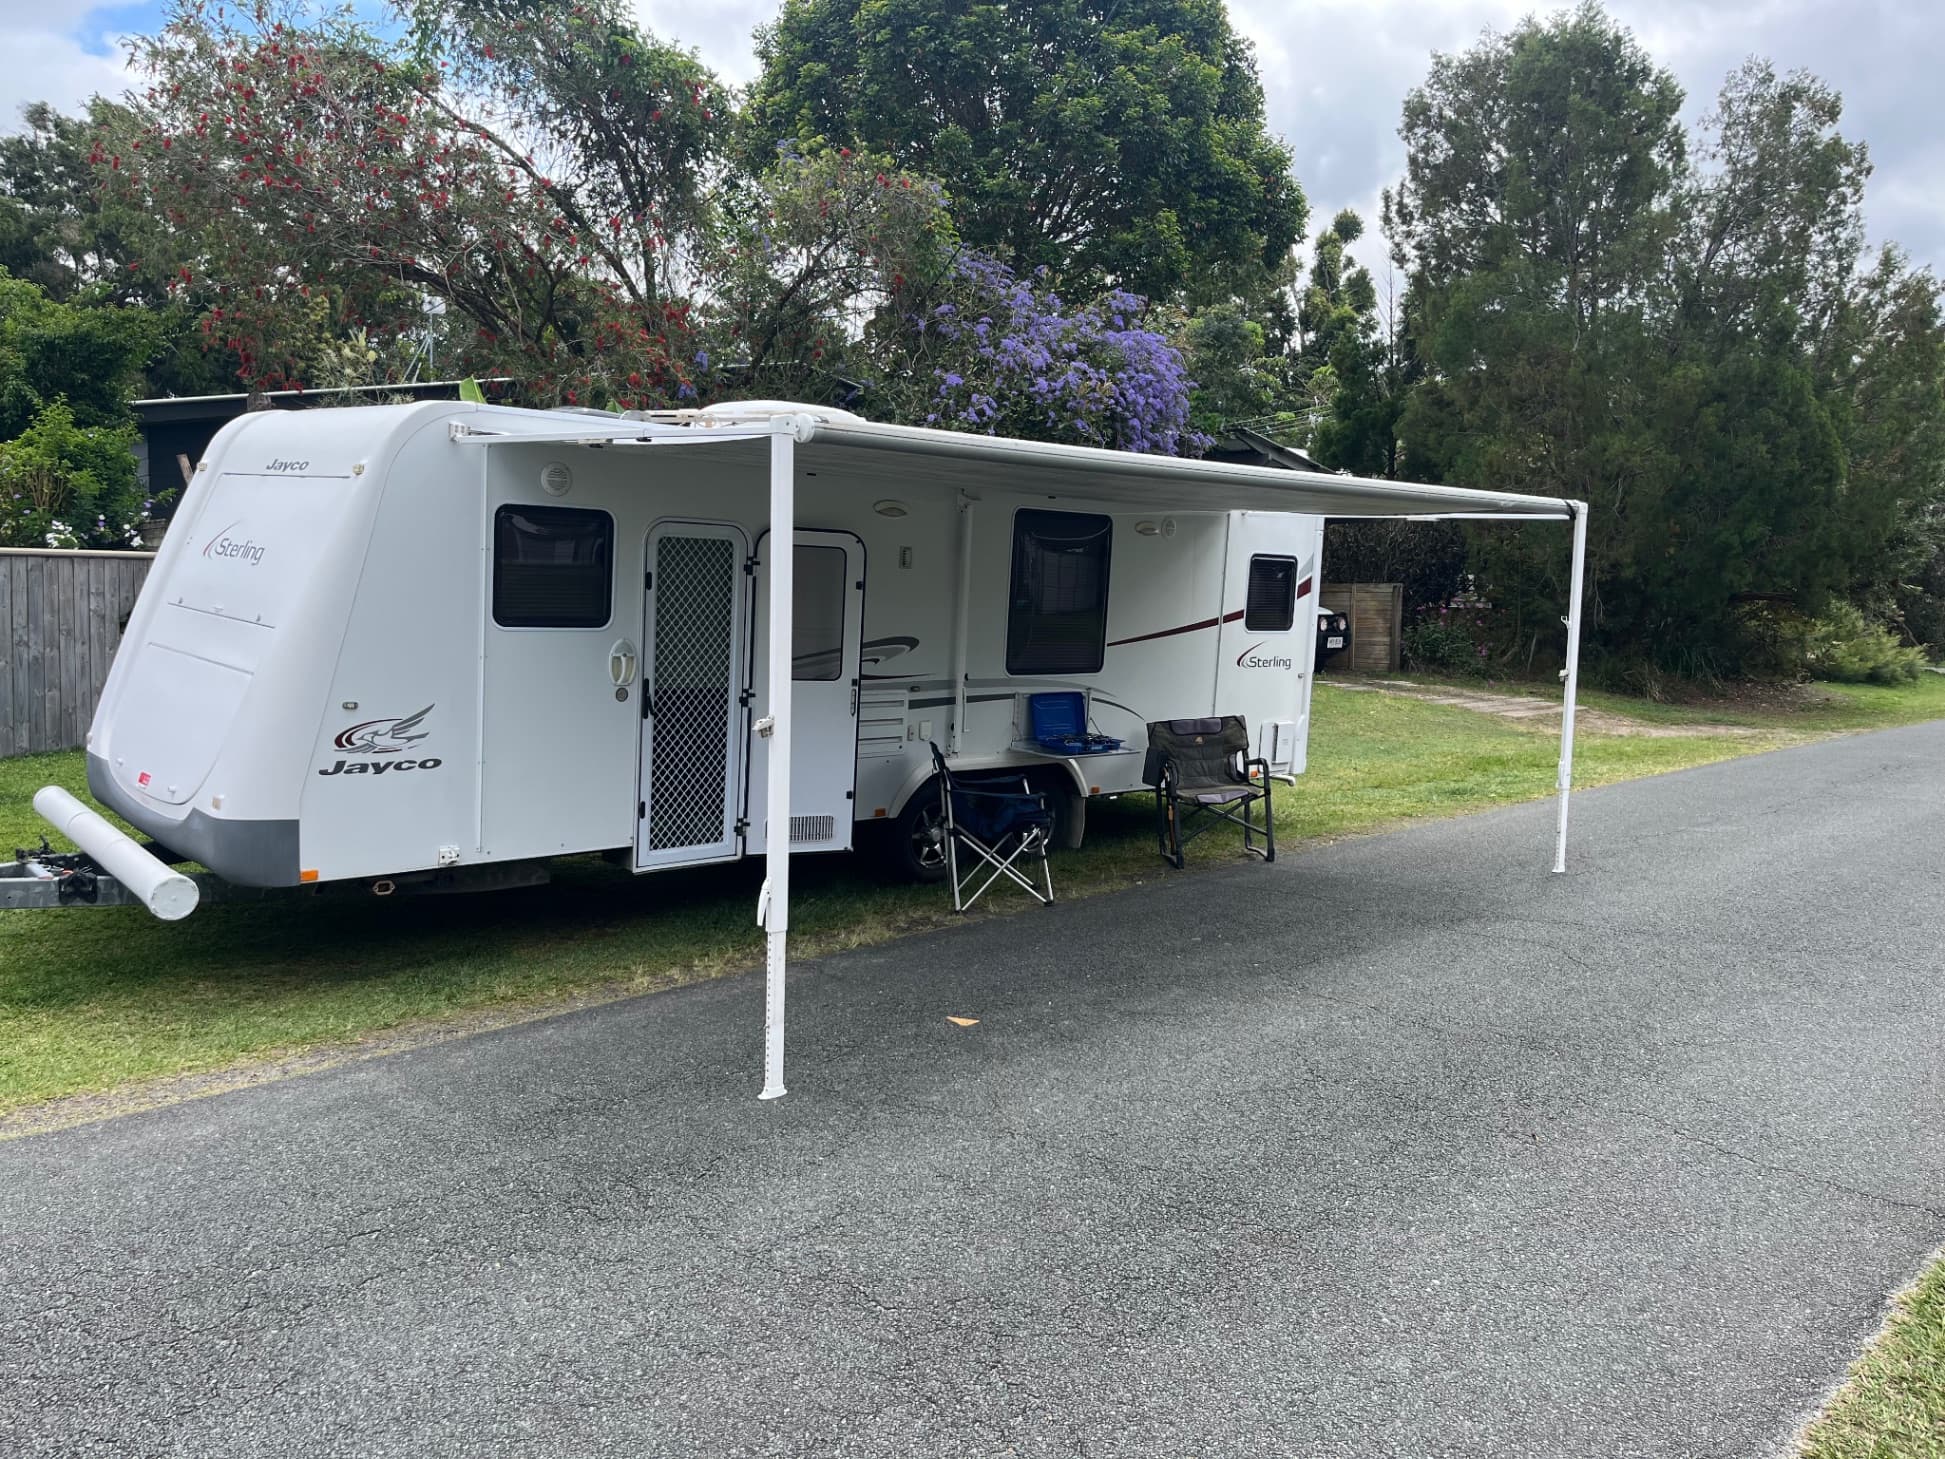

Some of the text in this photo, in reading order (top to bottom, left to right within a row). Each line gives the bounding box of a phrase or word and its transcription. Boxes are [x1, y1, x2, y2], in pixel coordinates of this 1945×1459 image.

[266, 459, 309, 472] Jayco
[214, 538, 265, 566] Sterling
[1246, 656, 1291, 670] Sterling
[318, 758, 442, 776] Jayco
